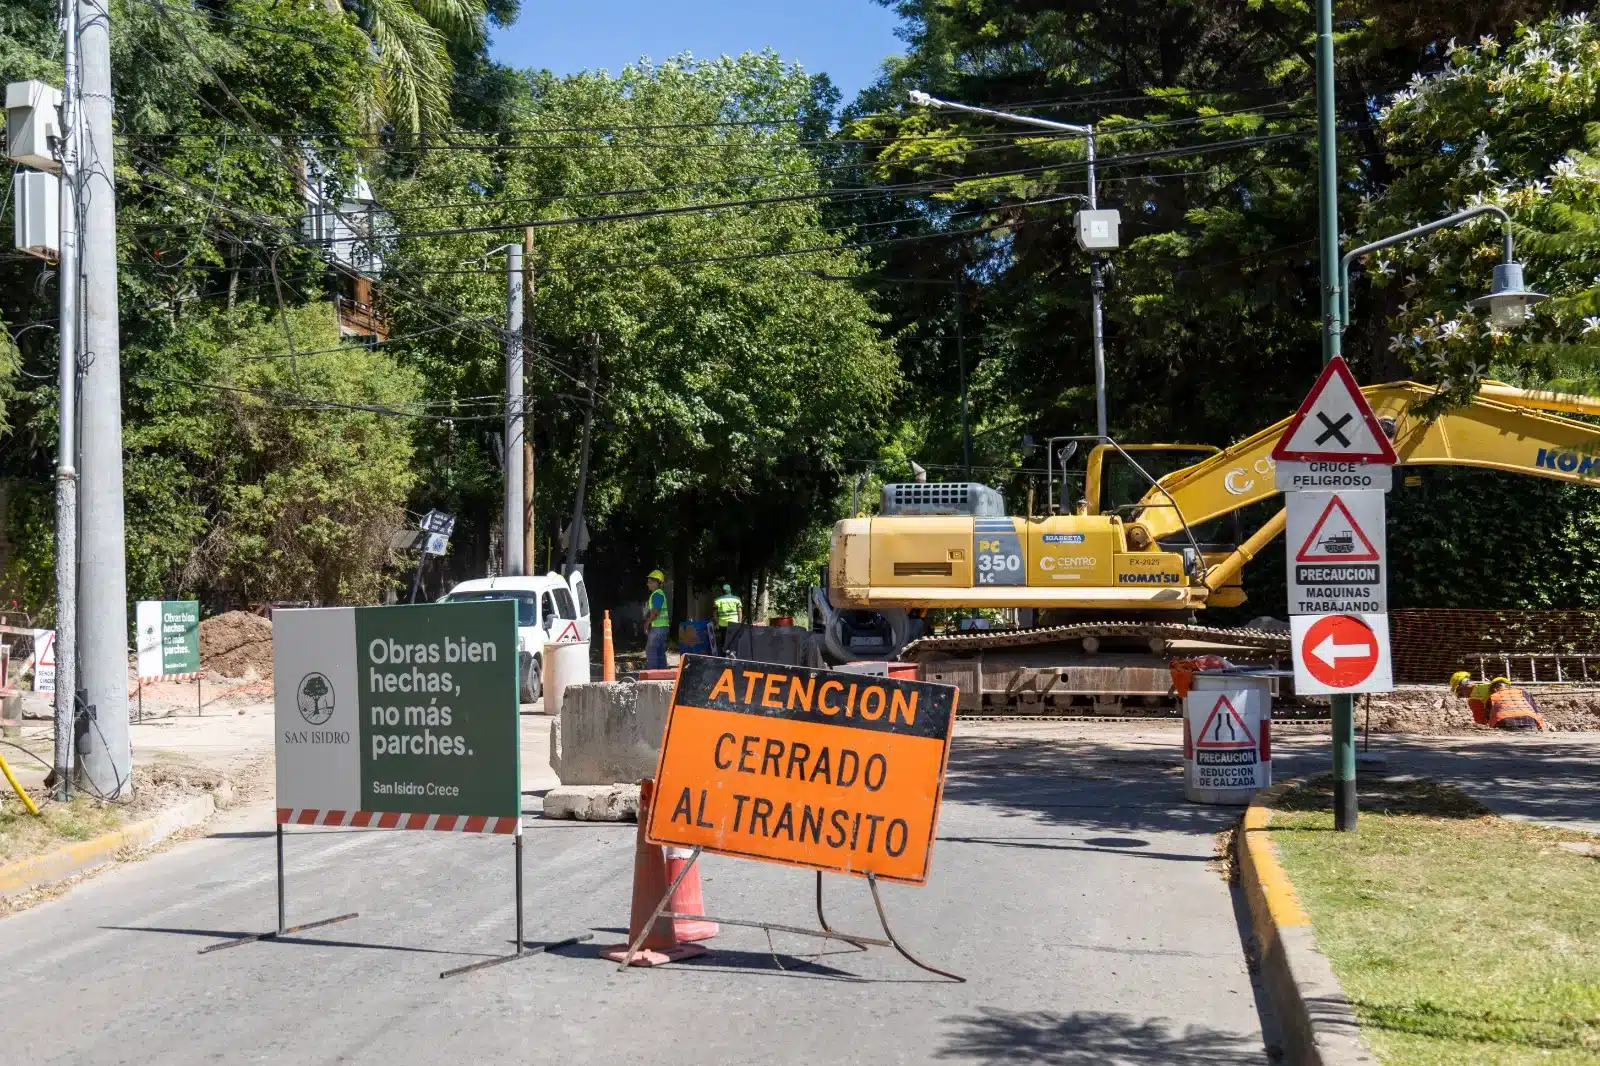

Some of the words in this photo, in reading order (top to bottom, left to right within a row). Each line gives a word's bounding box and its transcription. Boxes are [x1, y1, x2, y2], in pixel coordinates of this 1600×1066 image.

[1309, 462, 1356, 472] CRUCE
[1293, 475, 1372, 486] PELIGROSO
[979, 540, 1000, 552] PC
[978, 554, 1020, 571] 350
[1058, 557, 1097, 566] CENTRO
[979, 572, 995, 583] LC
[1119, 572, 1180, 583] KOMATSU
[1300, 568, 1376, 581] PRECAUCION
[1306, 587, 1370, 598] MAQUINAS
[1298, 602, 1379, 612] TRABAJANDO
[164, 612, 181, 623] Obras
[181, 612, 195, 622] bien
[163, 623, 187, 633] hechas,
[164, 644, 190, 656] parches.
[369, 638, 440, 664] Obras
[445, 636, 497, 662] bien
[370, 666, 461, 697] hechas,
[708, 667, 918, 725] ATENCION
[371, 706, 399, 726] no
[404, 698, 452, 726] más
[284, 731, 308, 744] SAN
[311, 731, 350, 745] ISIDRO
[372, 729, 473, 760] parches.
[714, 732, 887, 792] CERRADO
[1200, 752, 1254, 763] PRECAUCION
[1200, 767, 1254, 777] REDUCCION
[1199, 777, 1211, 787] DE
[1213, 777, 1256, 787] CALZADA
[373, 781, 393, 795] San
[394, 781, 424, 795] Isidro
[426, 782, 459, 797] Crece
[671, 787, 714, 829] AL
[732, 793, 908, 858] TRANSITO
